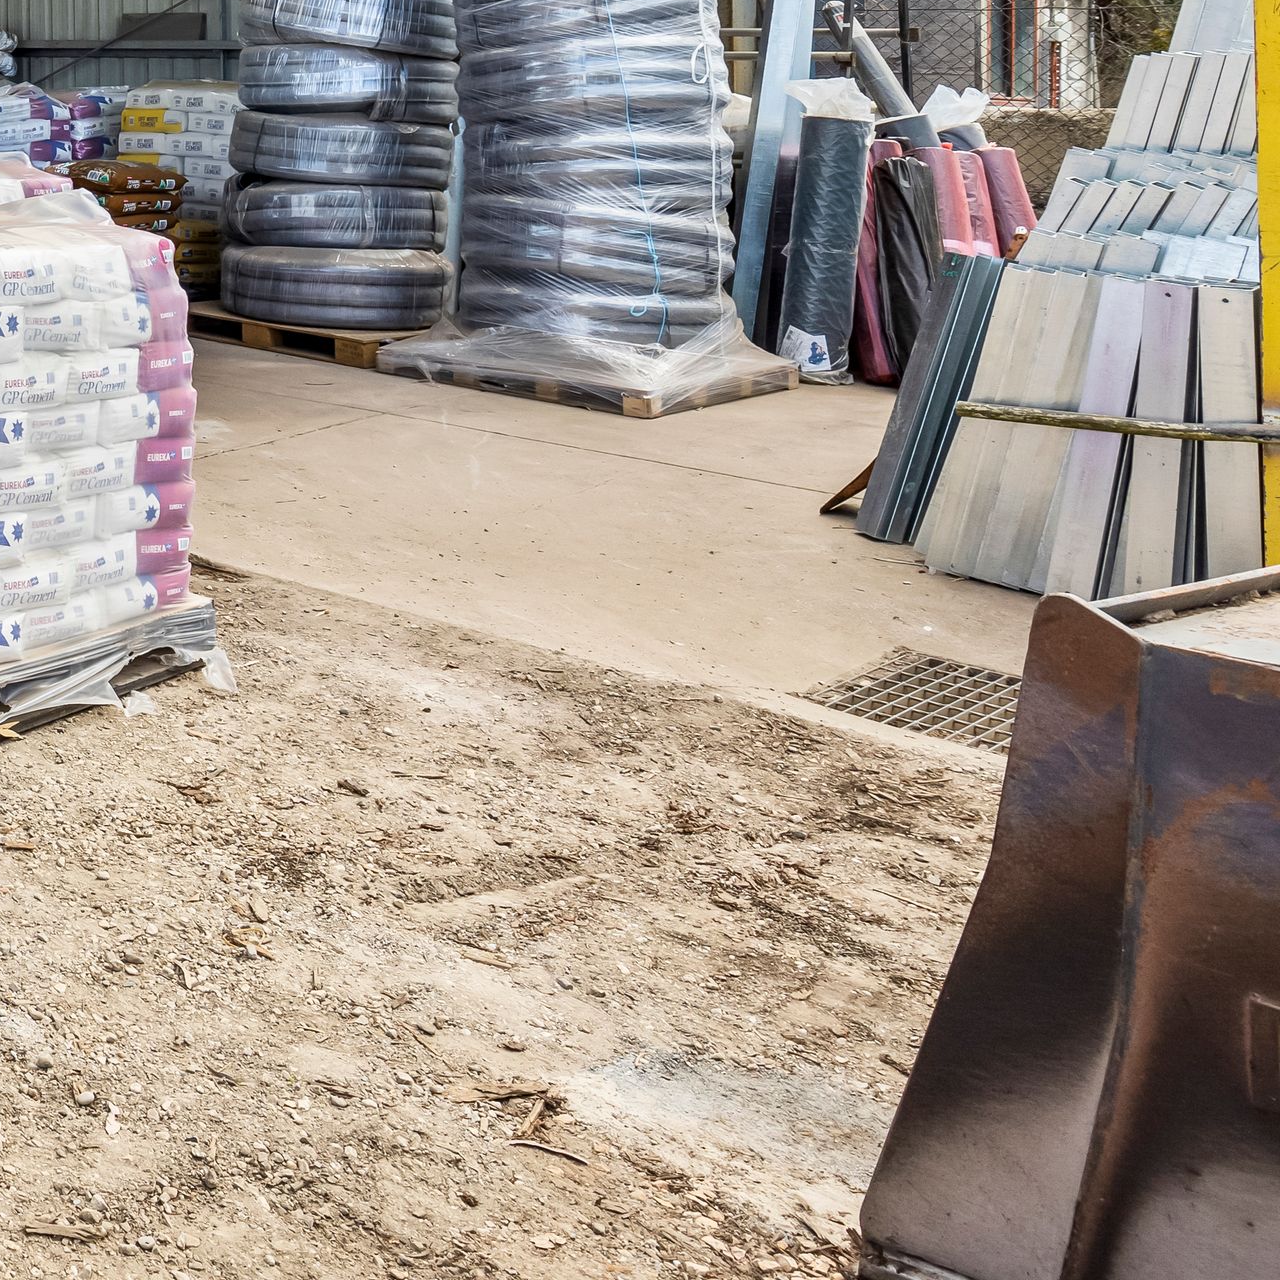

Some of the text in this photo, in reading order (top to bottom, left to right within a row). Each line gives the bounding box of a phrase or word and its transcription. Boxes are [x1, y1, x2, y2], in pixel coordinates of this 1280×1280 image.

[3, 281, 55, 296] GP Cement
[150, 359, 172, 368] EUREKA
[82, 370, 104, 379] EUREKA
[4, 379, 29, 389] EUREKA
[78, 380, 126, 394] GP Cement
[1, 388, 56, 405] GP Cement
[148, 452, 171, 462] EUREKA
[0, 481, 27, 490] EUREKA
[16, 489, 53, 505] Cement
[141, 544, 166, 553] EUREKA
[4, 580, 32, 590] EUREKA
[0, 588, 57, 607] GP Cement
